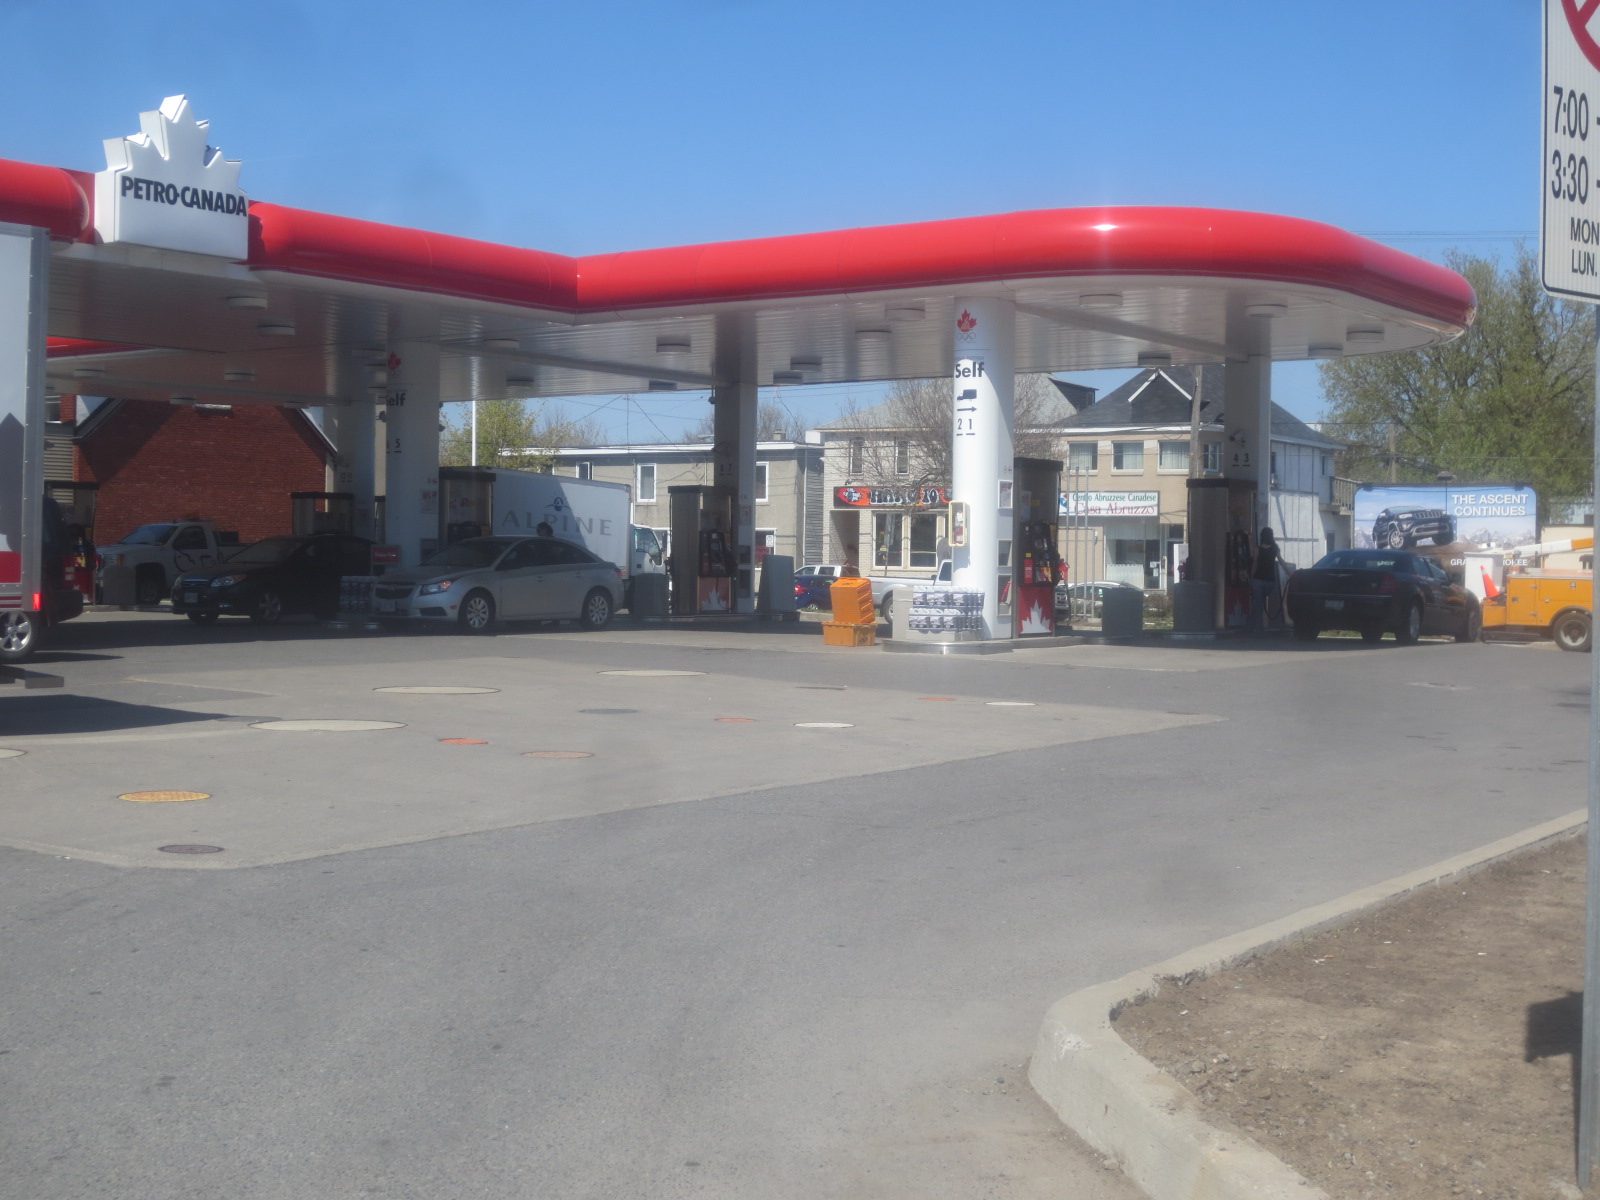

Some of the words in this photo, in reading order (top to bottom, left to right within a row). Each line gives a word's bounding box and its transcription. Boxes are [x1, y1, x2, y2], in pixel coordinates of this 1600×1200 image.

[1553, 85, 1589, 141] 7:00
[1551, 149, 1589, 205] 3:30
[955, 361, 985, 378] Self
[957, 418, 963, 430] 2
[1233, 453, 1239, 463] 4
[1244, 452, 1250, 463] 3
[1072, 493, 1093, 502] Cento
[1094, 493, 1126, 502] Abruzzese
[1127, 493, 1157, 502] Canadese
[1452, 494, 1476, 505] THE
[1479, 494, 1528, 505] ASCENT
[1106, 503, 1155, 515] Abruzzo
[1454, 506, 1526, 517] CONTINUES
[502, 510, 612, 536] ALPINE
